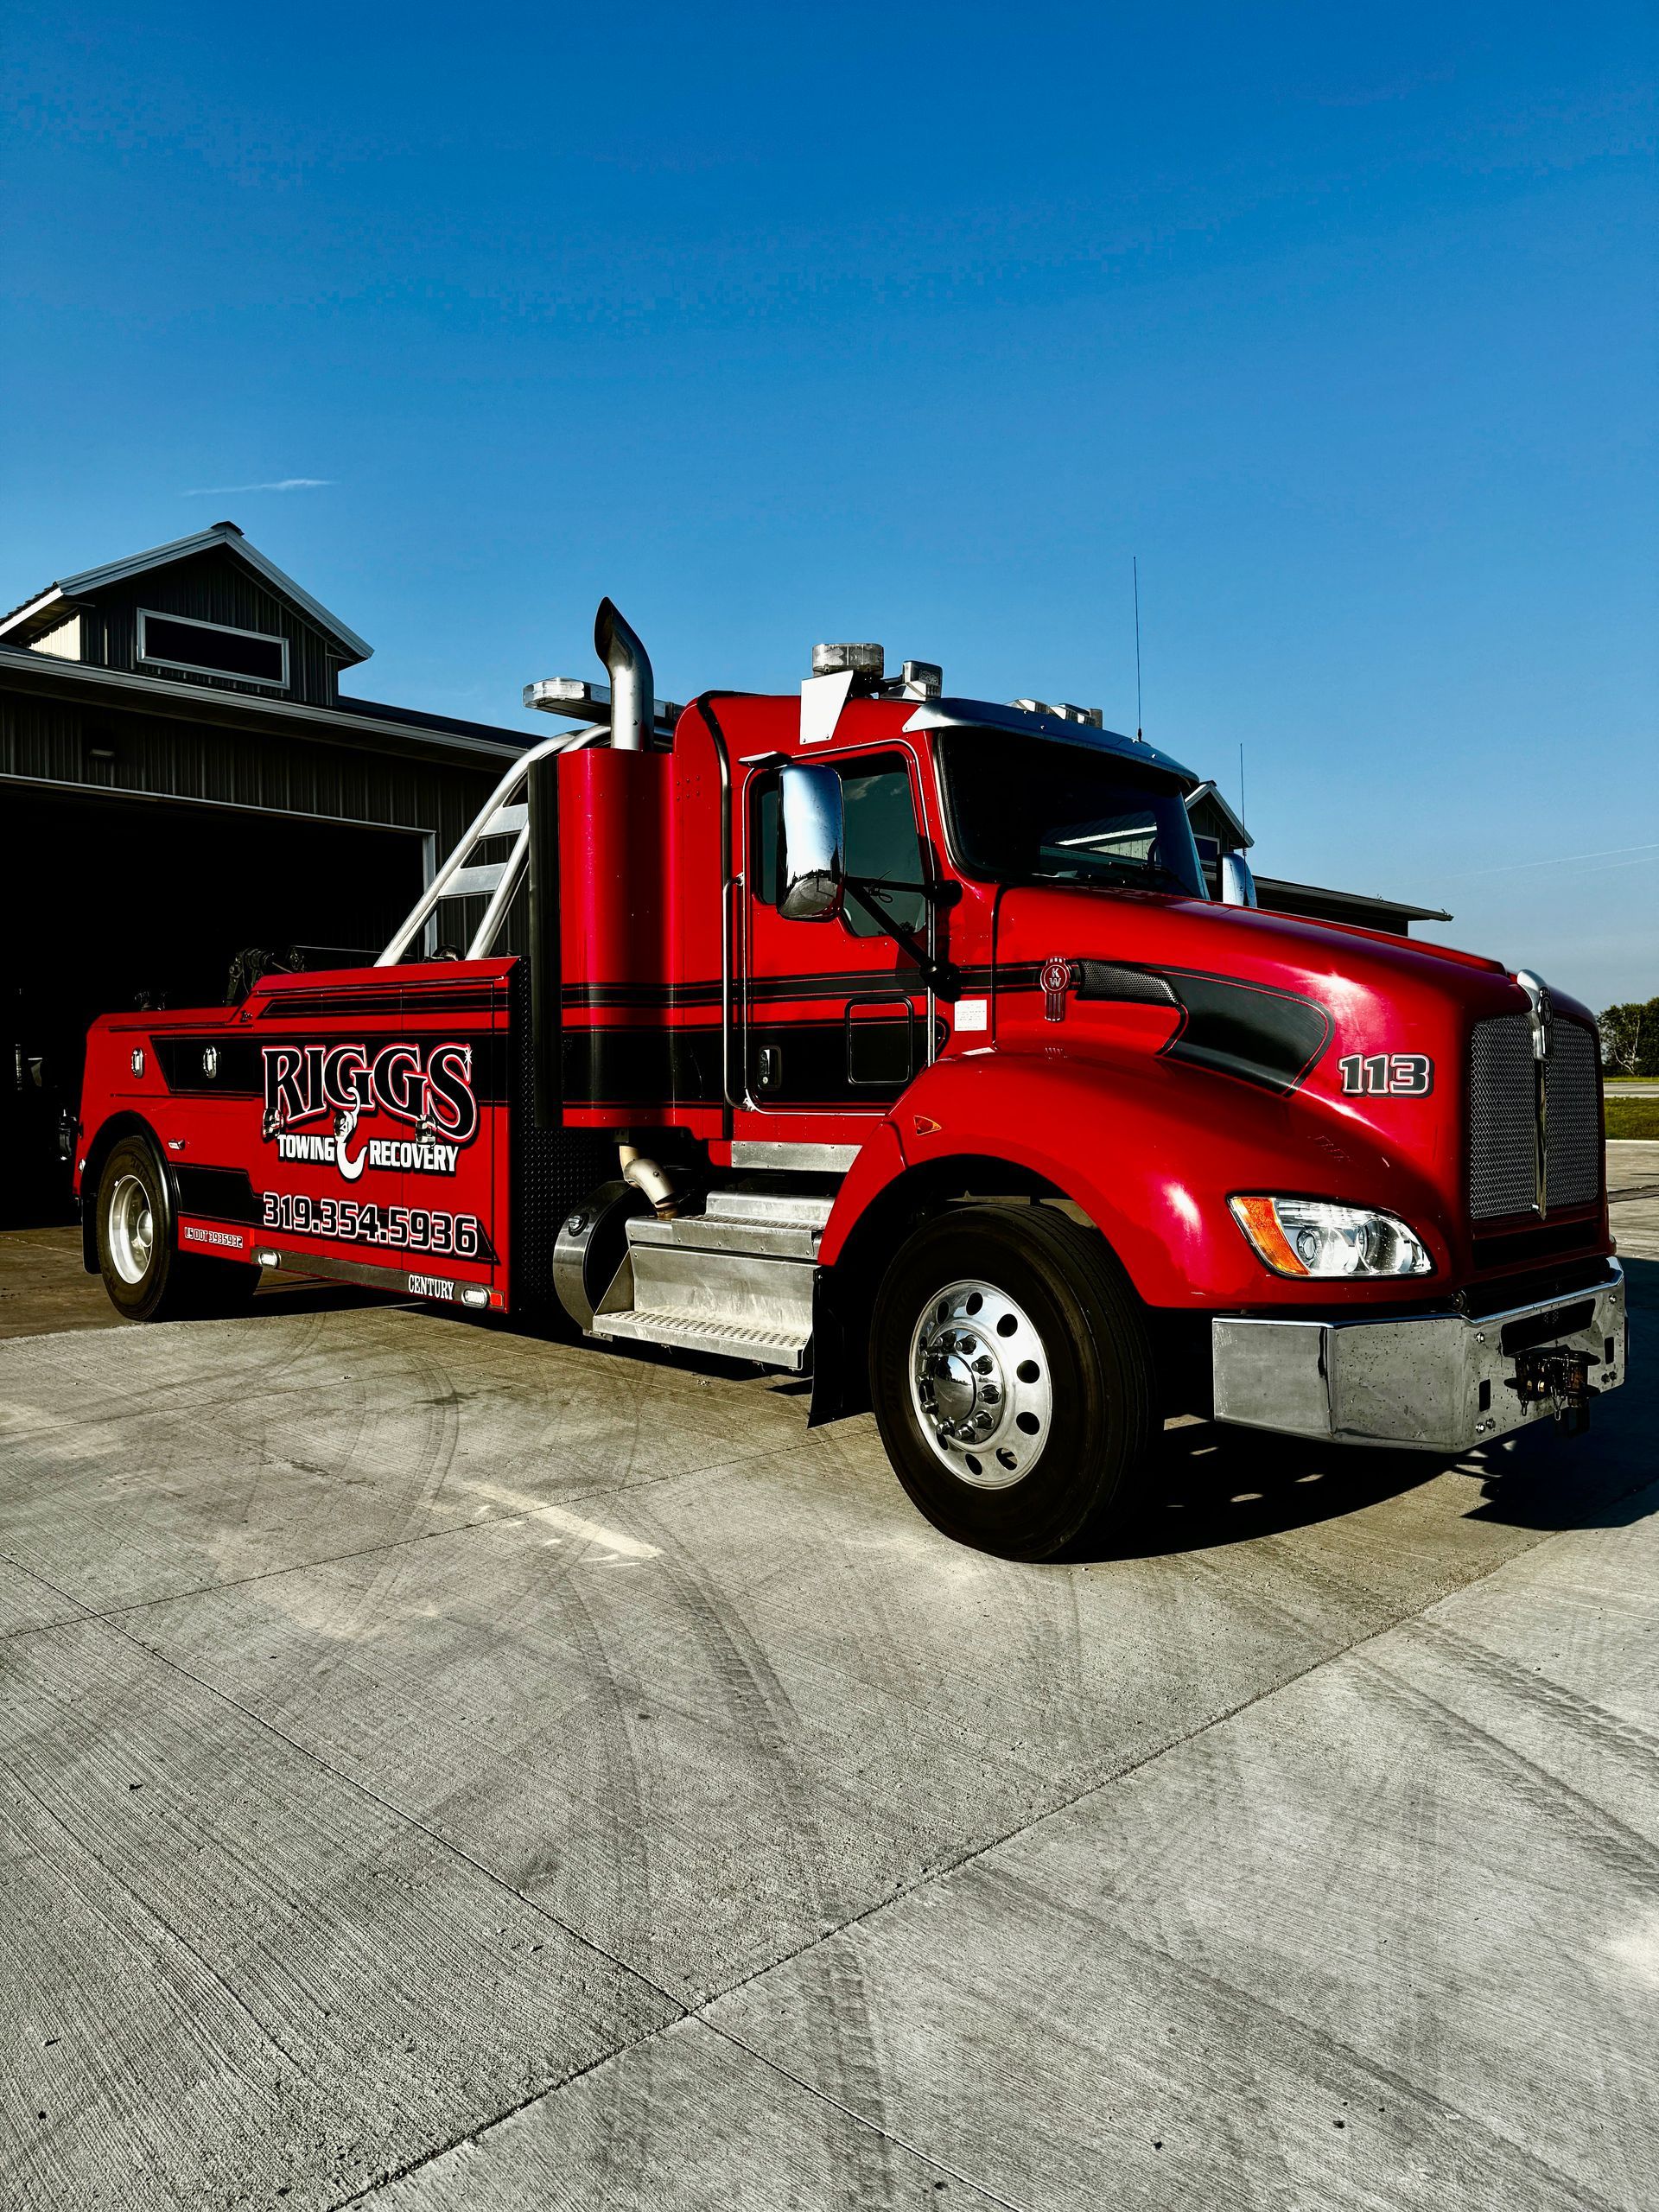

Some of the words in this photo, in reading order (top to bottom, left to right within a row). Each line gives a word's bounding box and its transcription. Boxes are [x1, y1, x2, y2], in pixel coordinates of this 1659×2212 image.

[262, 1043, 478, 1142] RIGGS
[1338, 1053, 1433, 1096] 113
[278, 1134, 334, 1162] TOWING
[369, 1140, 459, 1172] RECOVERY
[263, 1192, 479, 1257] 319.354.5936
[408, 1274, 454, 1300] CENTURY
